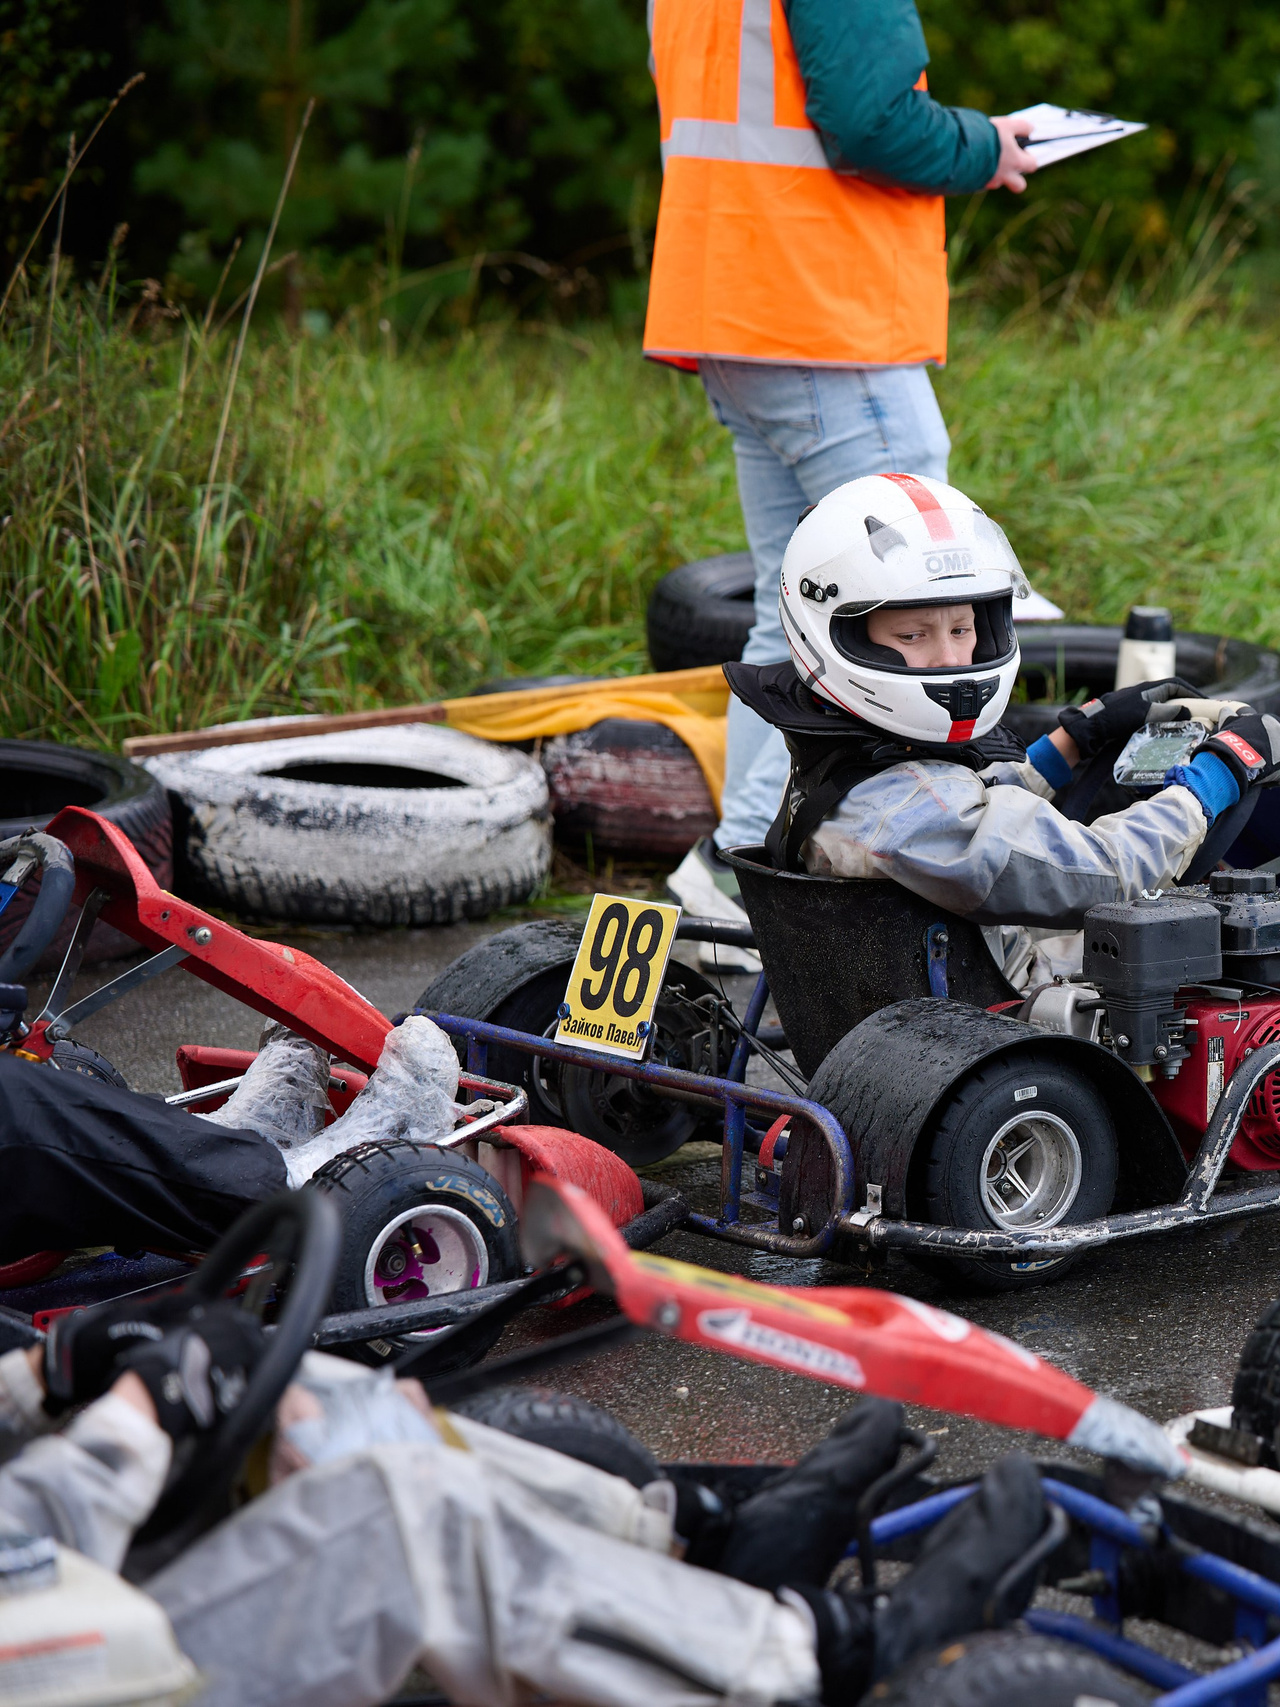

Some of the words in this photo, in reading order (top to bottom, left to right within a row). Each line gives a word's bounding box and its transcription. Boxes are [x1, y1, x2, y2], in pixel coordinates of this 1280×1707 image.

[925, 553, 973, 574] OMP
[1223, 735, 1256, 761] RLG
[580, 903, 664, 1018] 98
[563, 1013, 604, 1039] Зайков
[606, 1023, 641, 1047] Павел
[428, 1175, 504, 1226] VEGA
